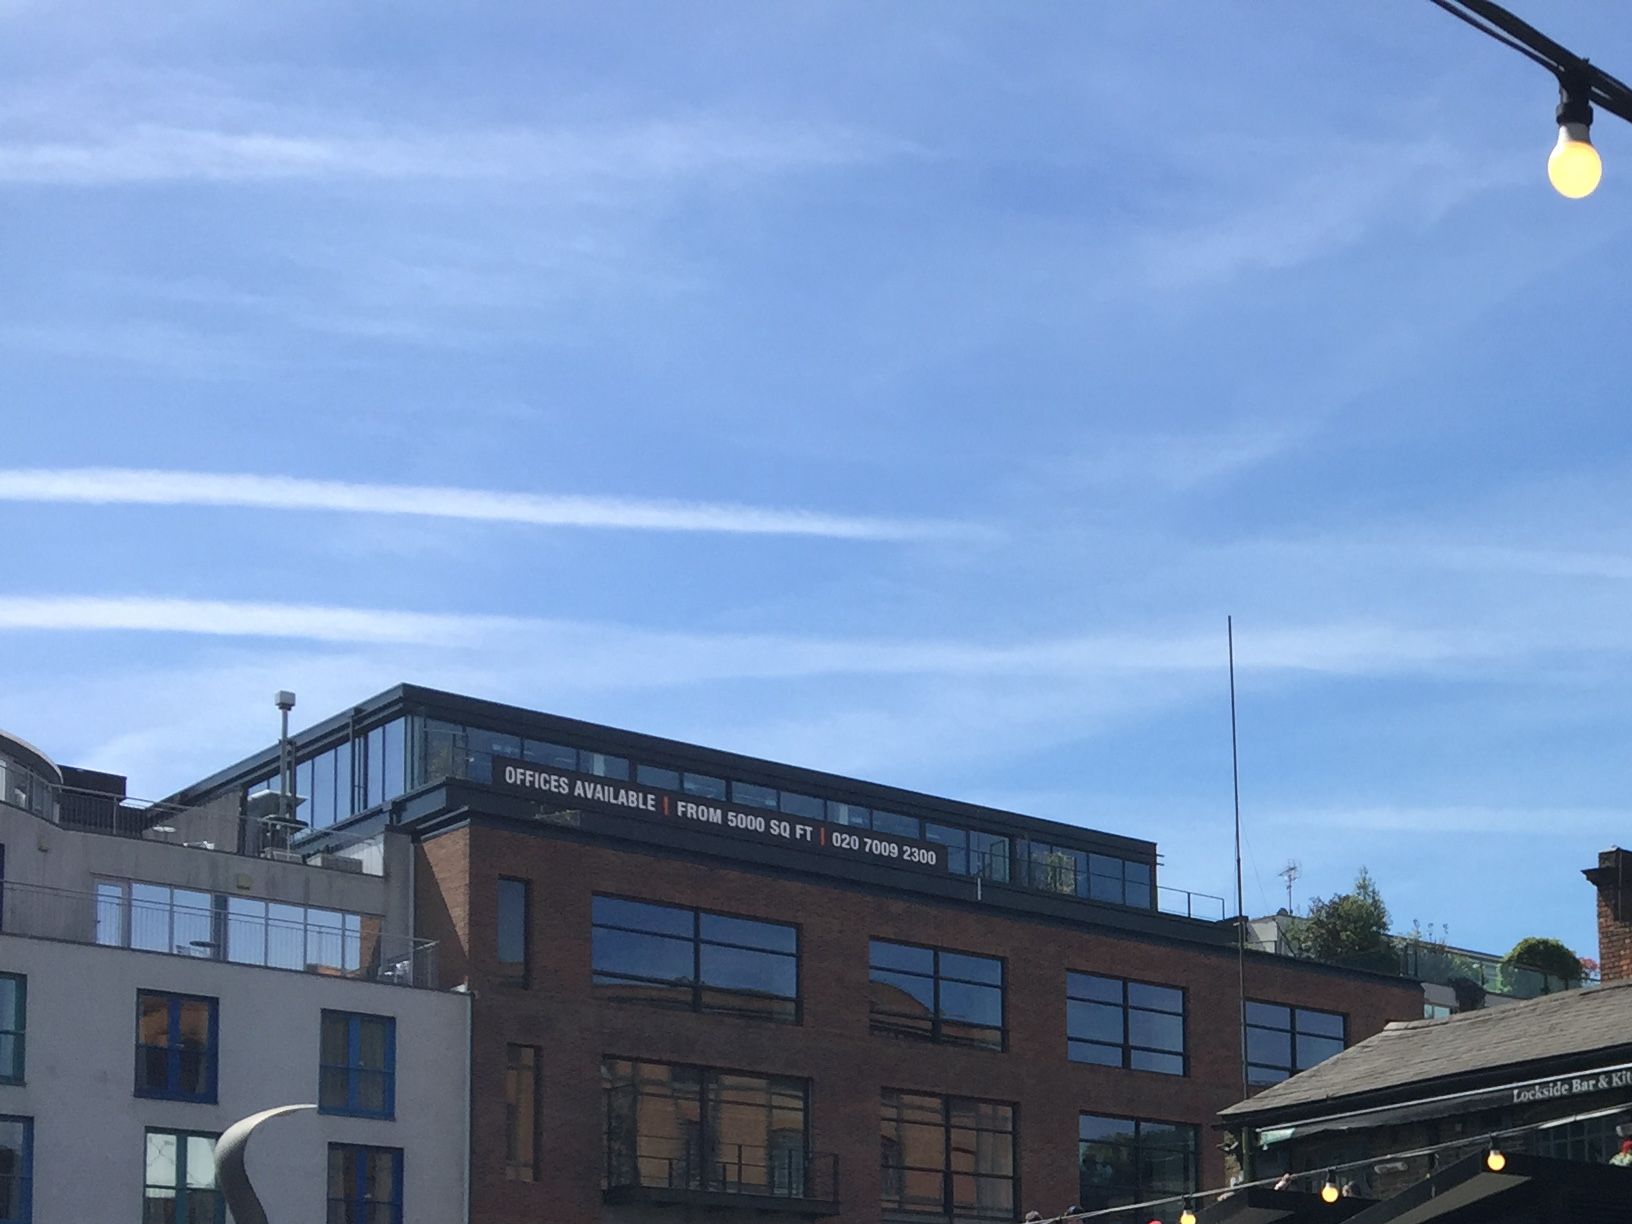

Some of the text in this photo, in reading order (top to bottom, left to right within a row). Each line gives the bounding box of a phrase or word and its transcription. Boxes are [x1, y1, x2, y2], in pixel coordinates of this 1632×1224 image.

[504, 766, 938, 866] OFFICES AVAILABLE FROM 5000 SQ FT 020 7009 2300
[1512, 1082, 1569, 1103] Lockside
[1572, 1078, 1596, 1094] Bar
[1598, 1075, 1609, 1089] &
